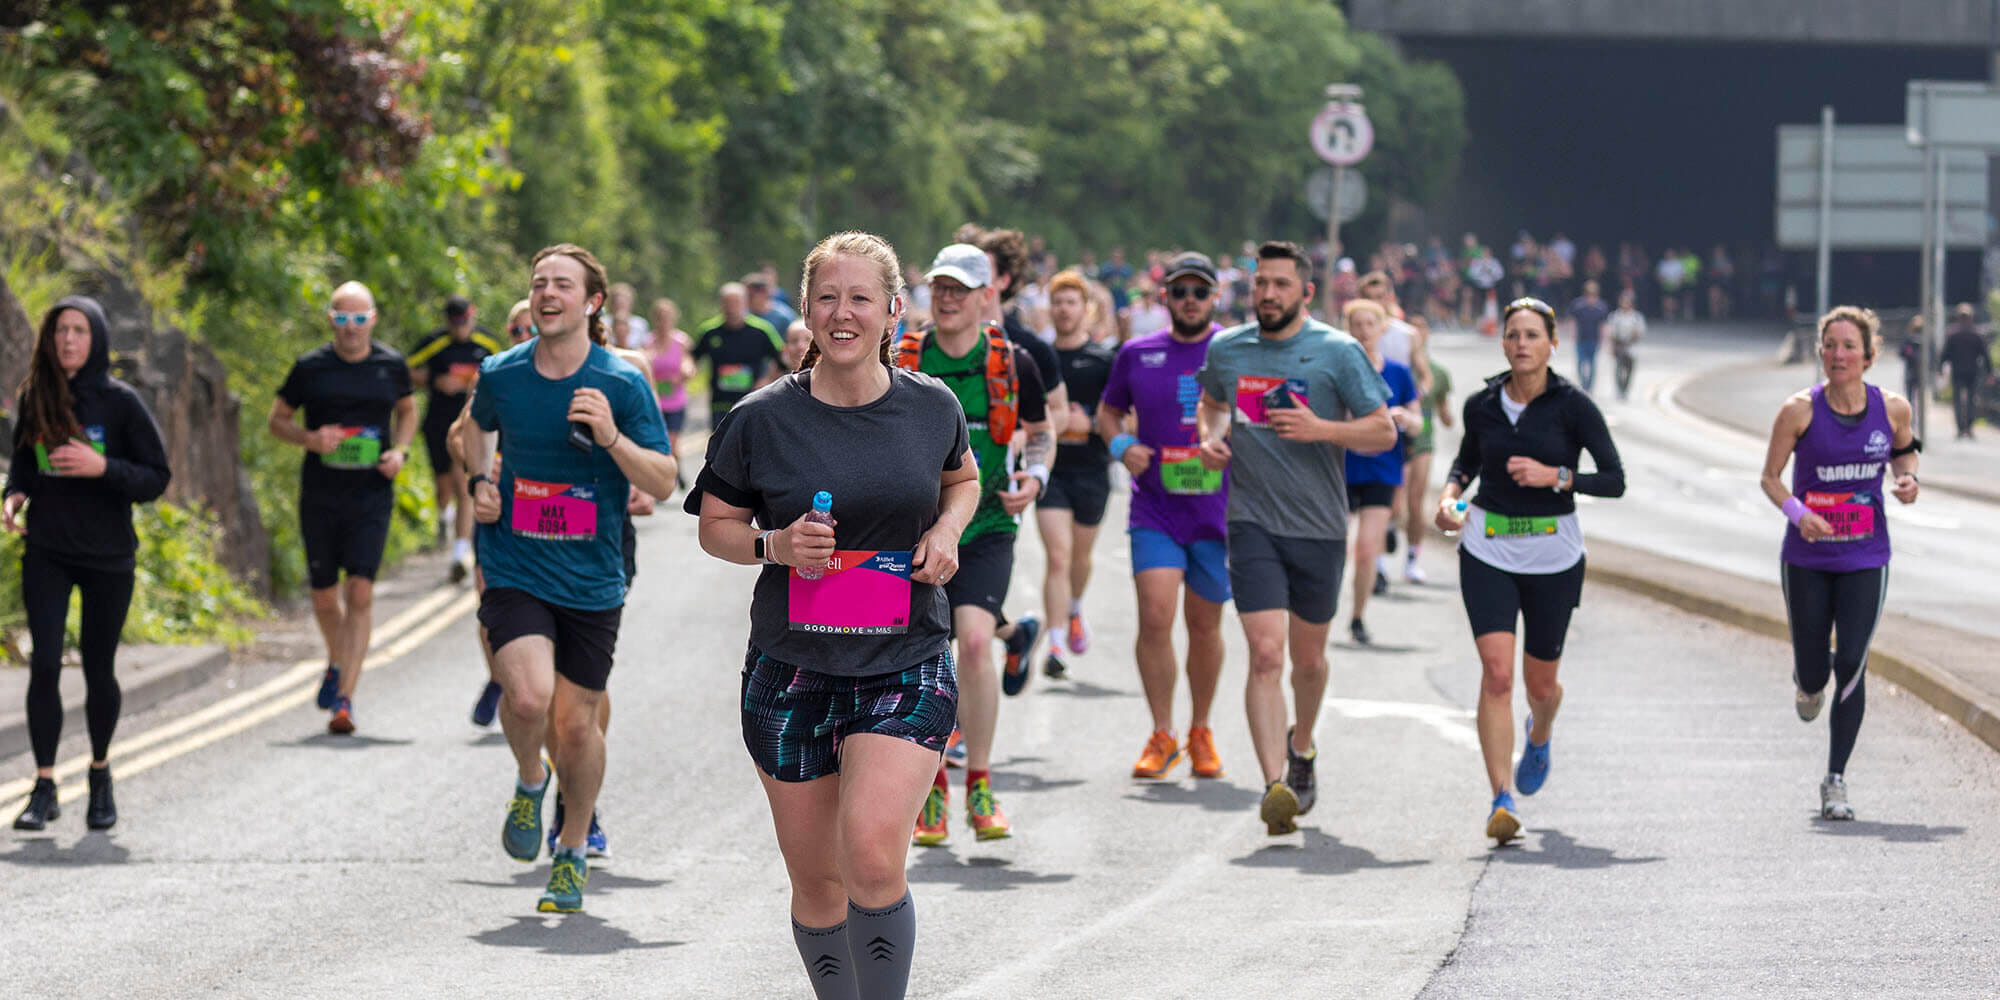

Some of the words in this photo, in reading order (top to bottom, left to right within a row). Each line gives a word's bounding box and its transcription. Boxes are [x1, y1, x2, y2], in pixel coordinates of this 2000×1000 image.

[1816, 462, 1882, 482] CAROLIN
[541, 503, 566, 520] MAX
[827, 557, 842, 570] ell
[804, 624, 864, 634] GOODMOVE
